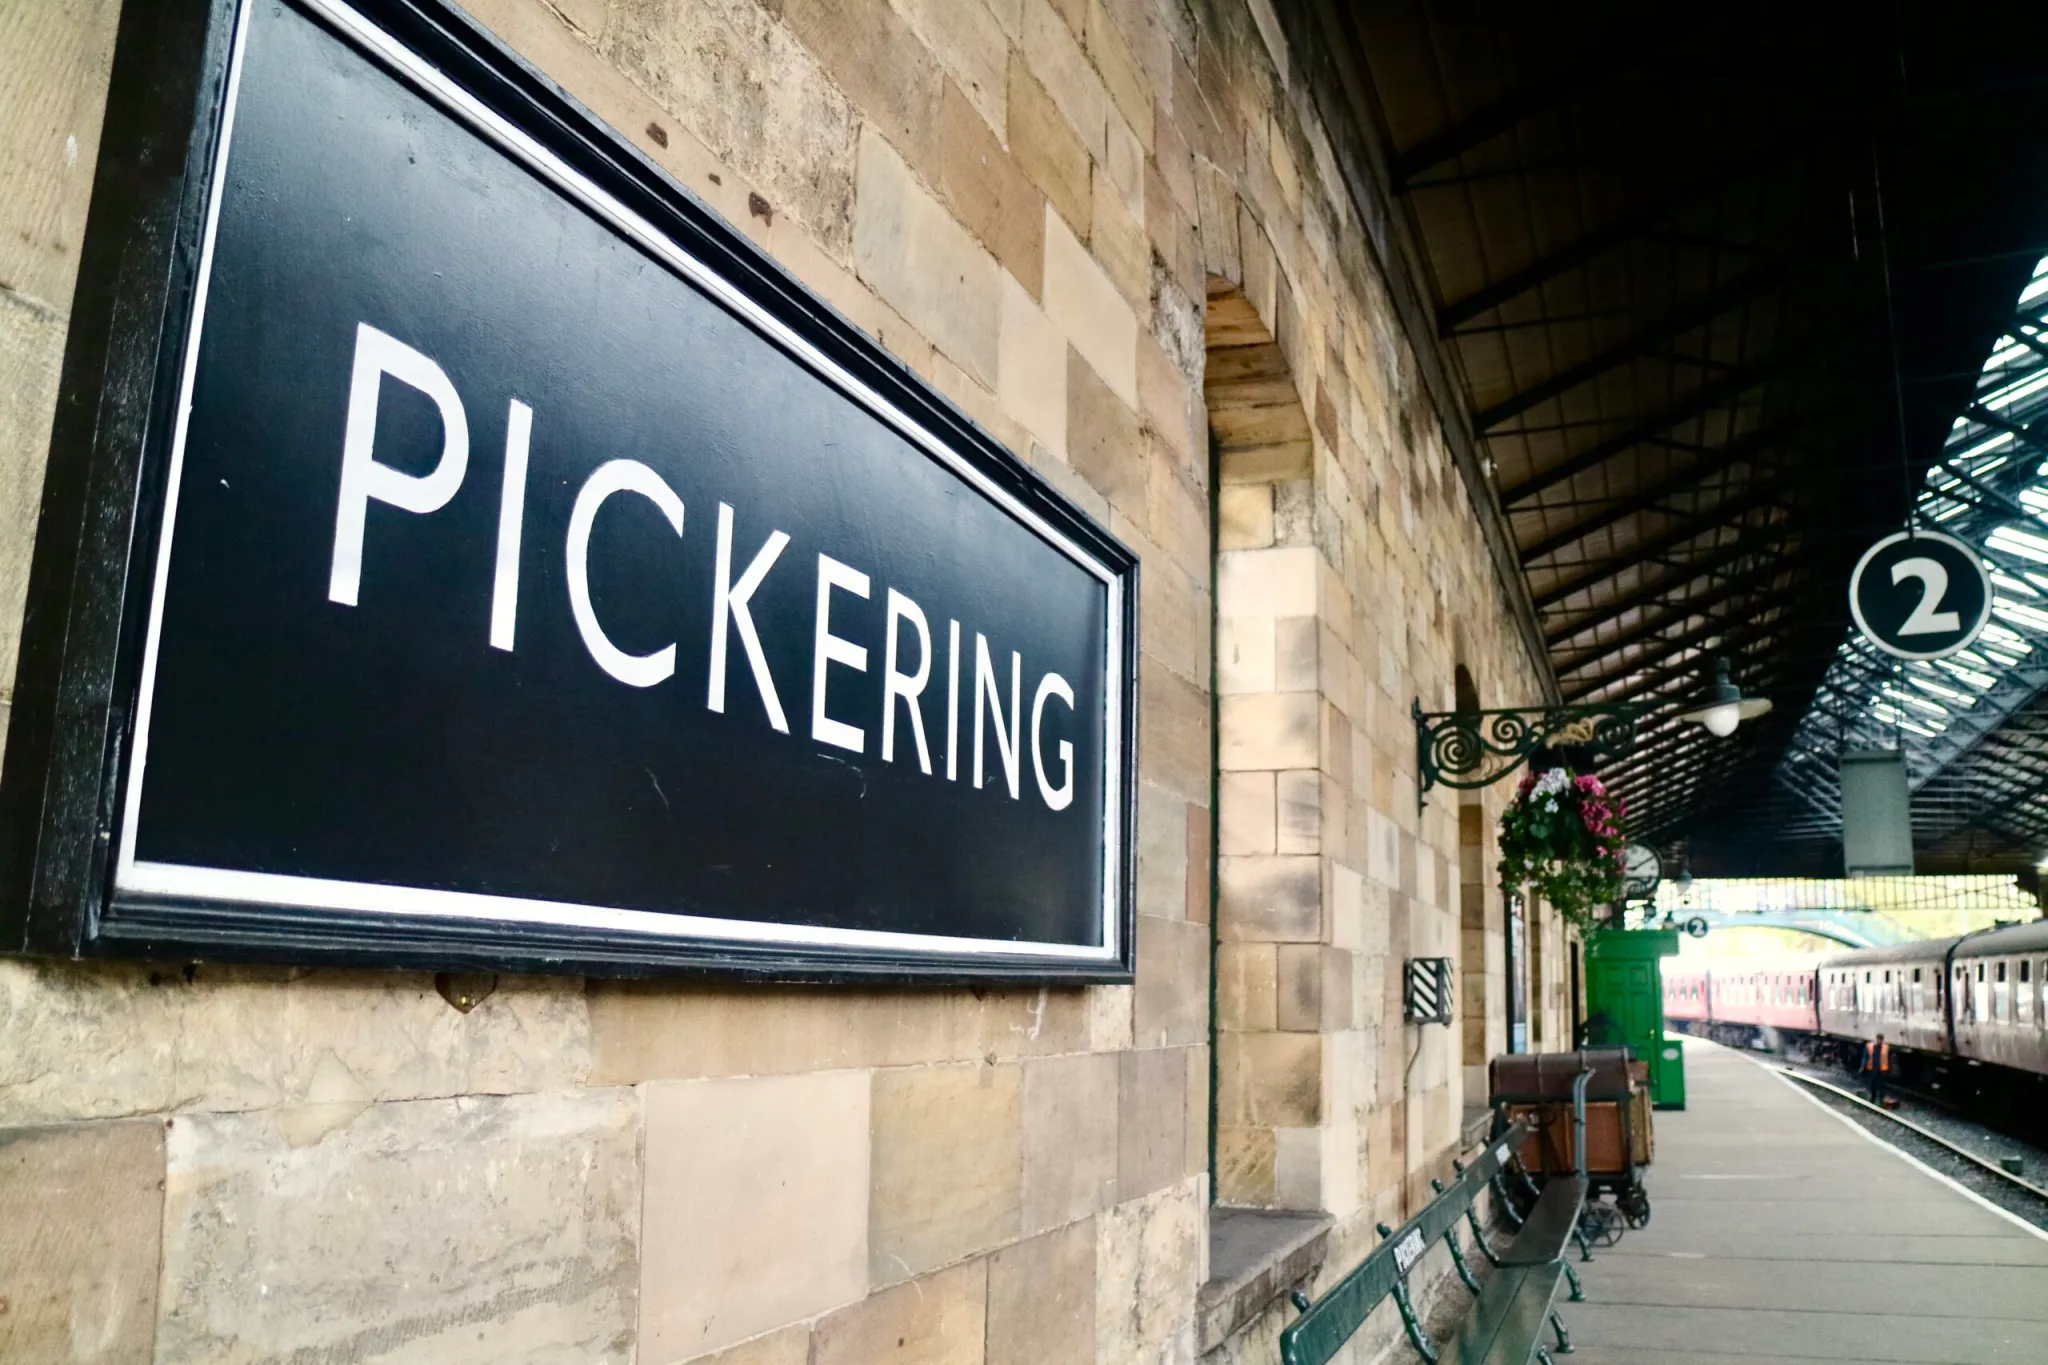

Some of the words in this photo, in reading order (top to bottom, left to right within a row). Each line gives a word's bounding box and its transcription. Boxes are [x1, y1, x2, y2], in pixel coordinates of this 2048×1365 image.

[326, 321, 1077, 812] PICKERING
[1890, 557, 1961, 636] 2
[1692, 919, 1704, 937] 2
